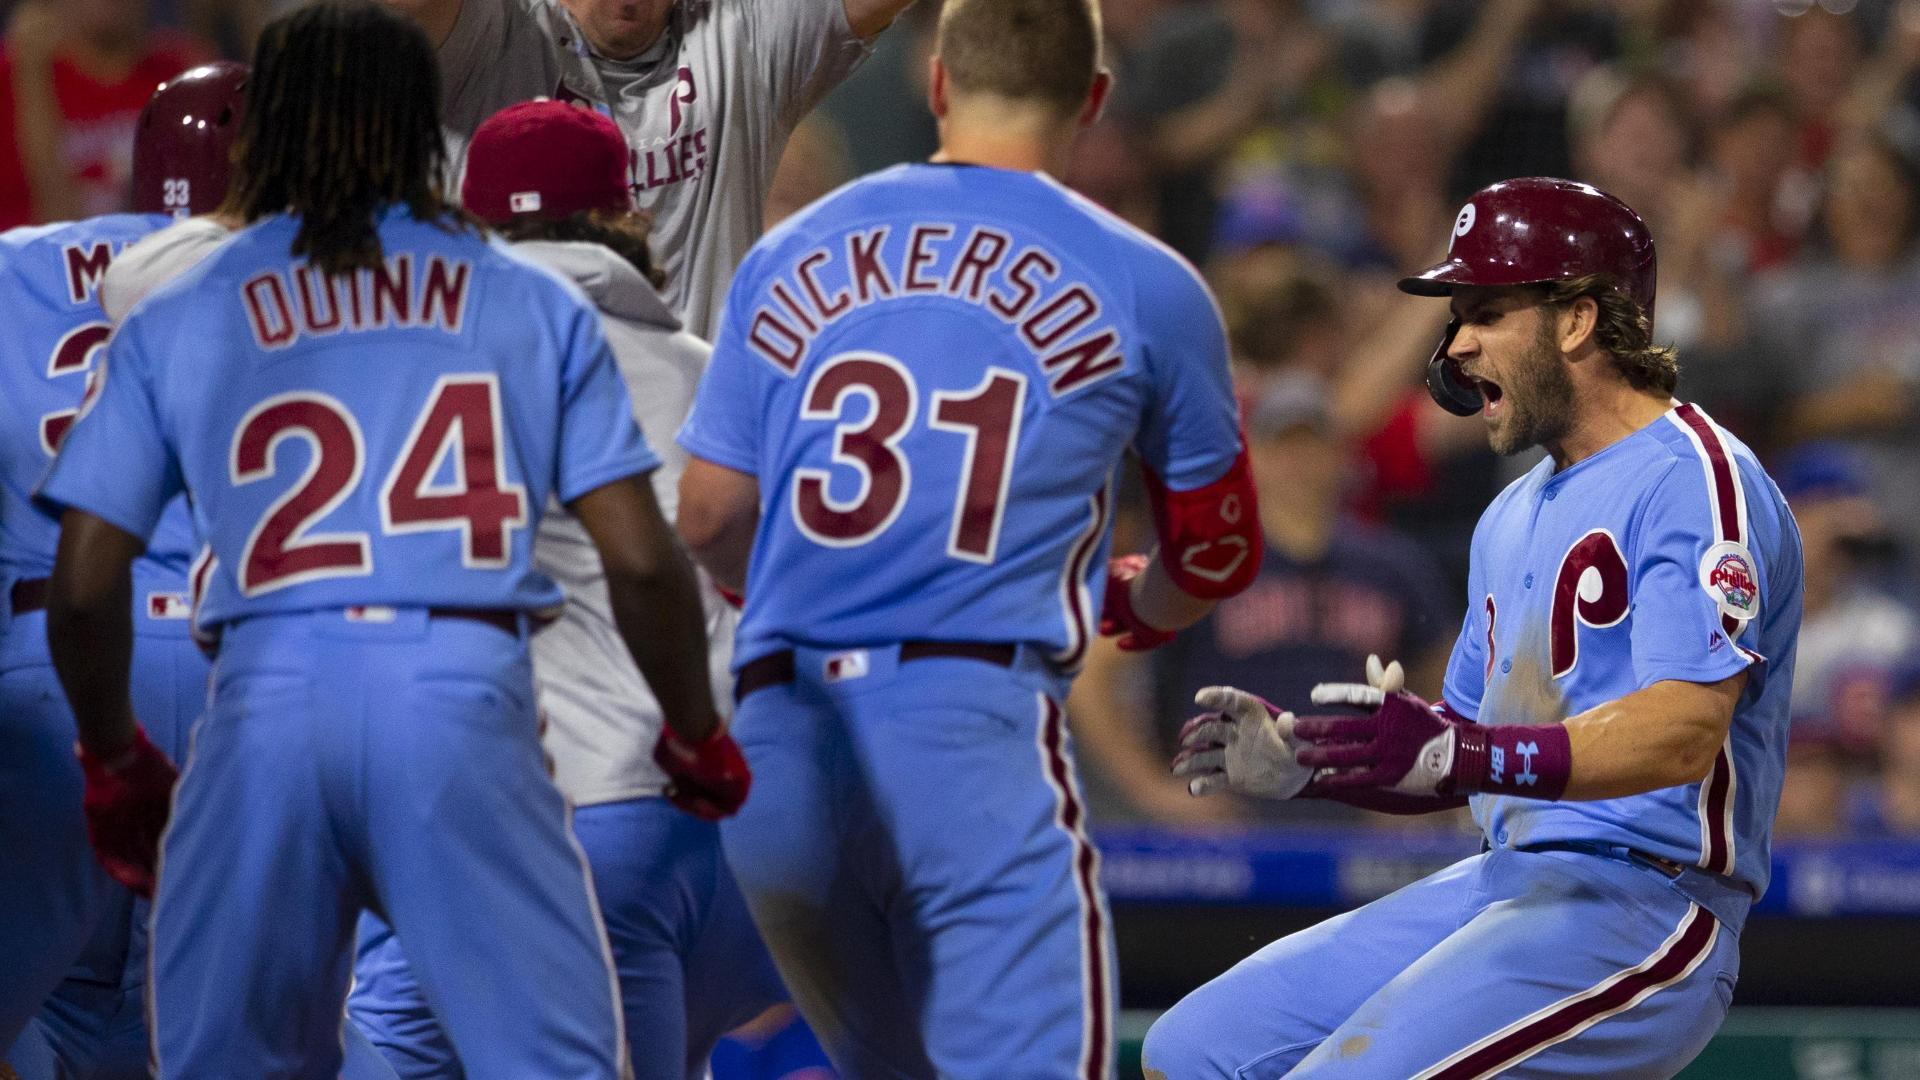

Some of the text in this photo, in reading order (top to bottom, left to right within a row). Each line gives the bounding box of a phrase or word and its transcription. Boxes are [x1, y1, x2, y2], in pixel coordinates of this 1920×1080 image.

[163, 178, 191, 206] 33
[241, 254, 471, 352] QUINN
[745, 223, 1126, 397] DICKERSON
[230, 372, 528, 597] 24
[792, 351, 1028, 565] 31
[1549, 527, 1630, 680] P
